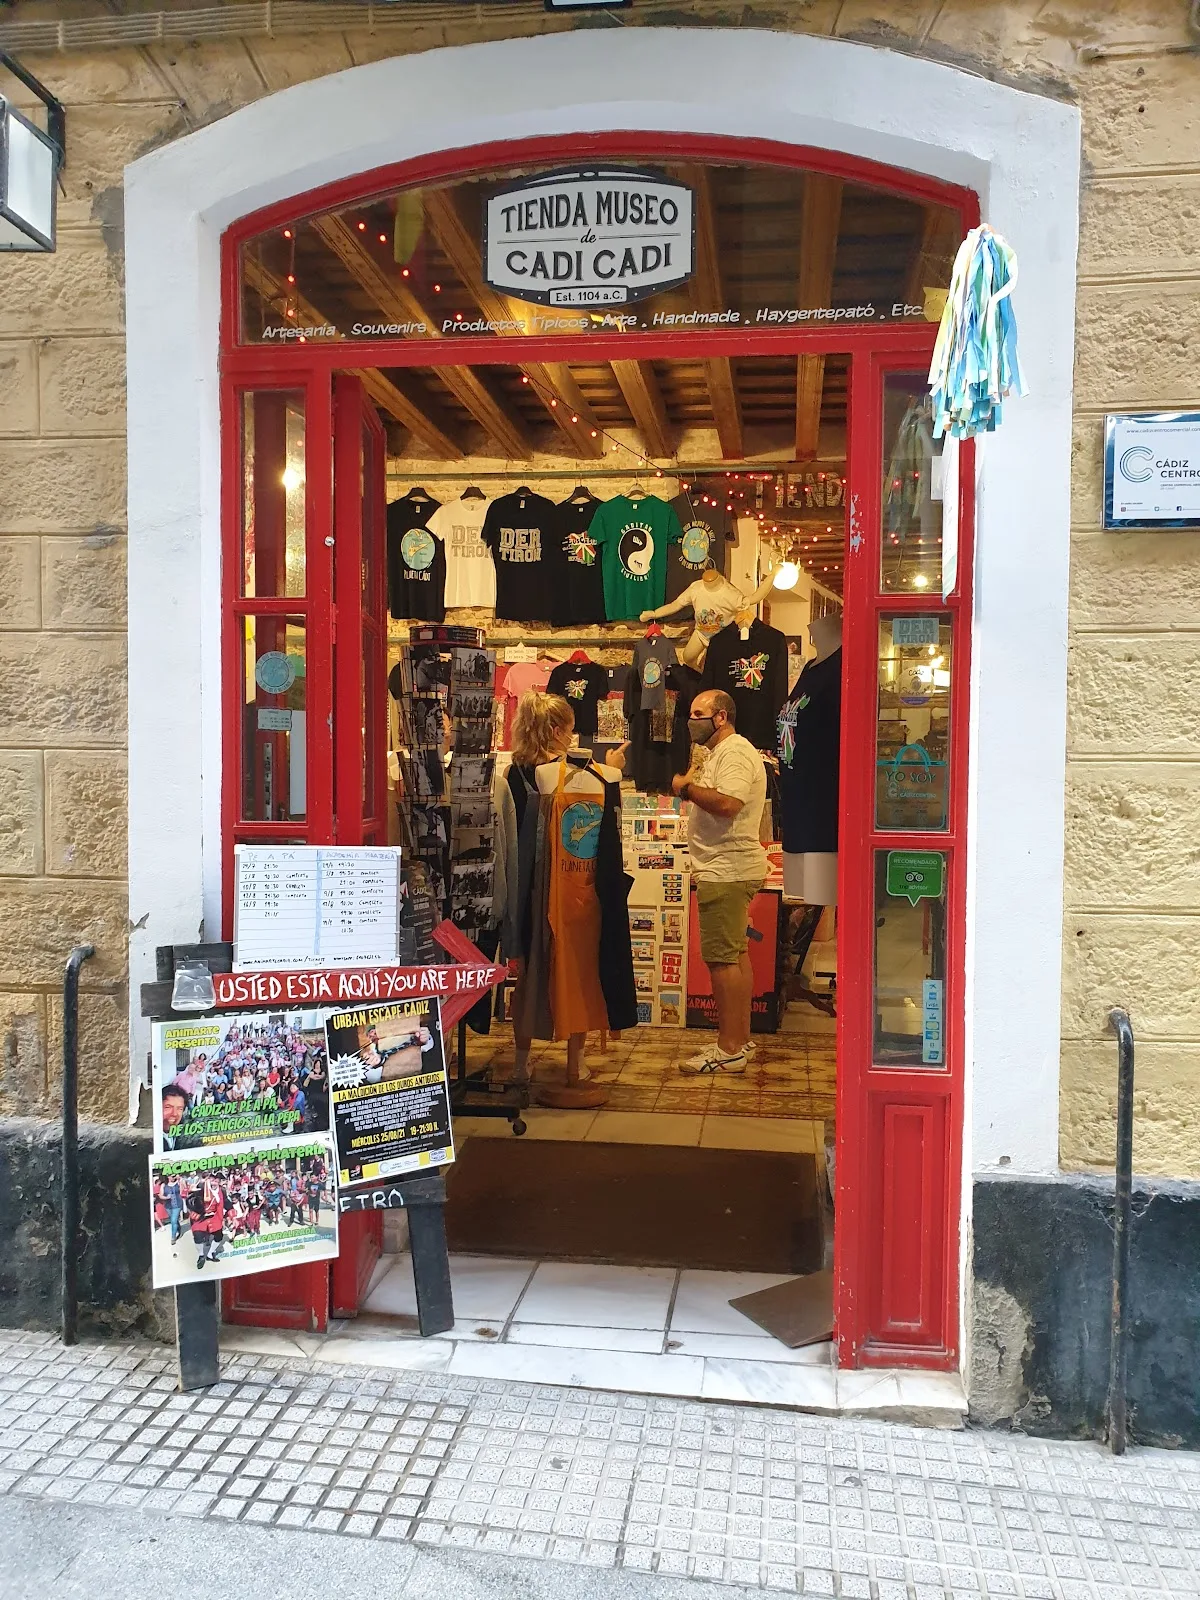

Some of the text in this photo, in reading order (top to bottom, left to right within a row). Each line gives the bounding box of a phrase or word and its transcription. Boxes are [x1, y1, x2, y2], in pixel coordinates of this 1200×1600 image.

[501, 191, 679, 233] TIENDA MUSEO
[580, 228, 598, 244] de
[505, 242, 672, 281] CADI CADI
[555, 290, 623, 302] Est. 1104 a.C.
[262, 323, 336, 339] Artesanía
[350, 321, 427, 336] Souvenirs
[441, 318, 526, 333] Productos
[531, 316, 588, 330] Típicos
[601, 313, 638, 327] Arte
[652, 310, 740, 326] Handmade
[756, 303, 875, 323] Haygentepató
[1156, 458, 1188, 468] CÁDIZ
[746, 472, 846, 508] TIEND
[452, 525, 484, 545] DE
[500, 528, 541, 548] DER
[499, 548, 542, 562] TIRON
[899, 634, 935, 644] TIRON
[886, 770, 936, 784] YO SOY
[561, 859, 590, 872] PLANETA
[219, 978, 282, 1002] USTED
[287, 973, 332, 998] ESTÁ
[420, 970, 449, 991] ARE
[456, 968, 495, 990] HERE
[332, 1010, 366, 1030] URBAN
[368, 1004, 402, 1024] ESCAPE
[338, 1092, 347, 1101] LA
[378, 1085, 385, 1094] DE
[386, 1083, 396, 1092] LOS
[415, 1073, 440, 1087] ANTIGUOS
[191, 1101, 222, 1118] CÁDIZ
[224, 1101, 237, 1114] DE
[240, 1096, 252, 1112] PÉ
[253, 1098, 262, 1108] A
[169, 1110, 300, 1138] DE LOS FENICIOS A LA PEPA
[202, 1135, 222, 1144] RUTA
[351, 1132, 380, 1149] MIÉRCOLES
[380, 1128, 405, 1143] 25/08/21
[234, 1237, 256, 1248] RUTA
